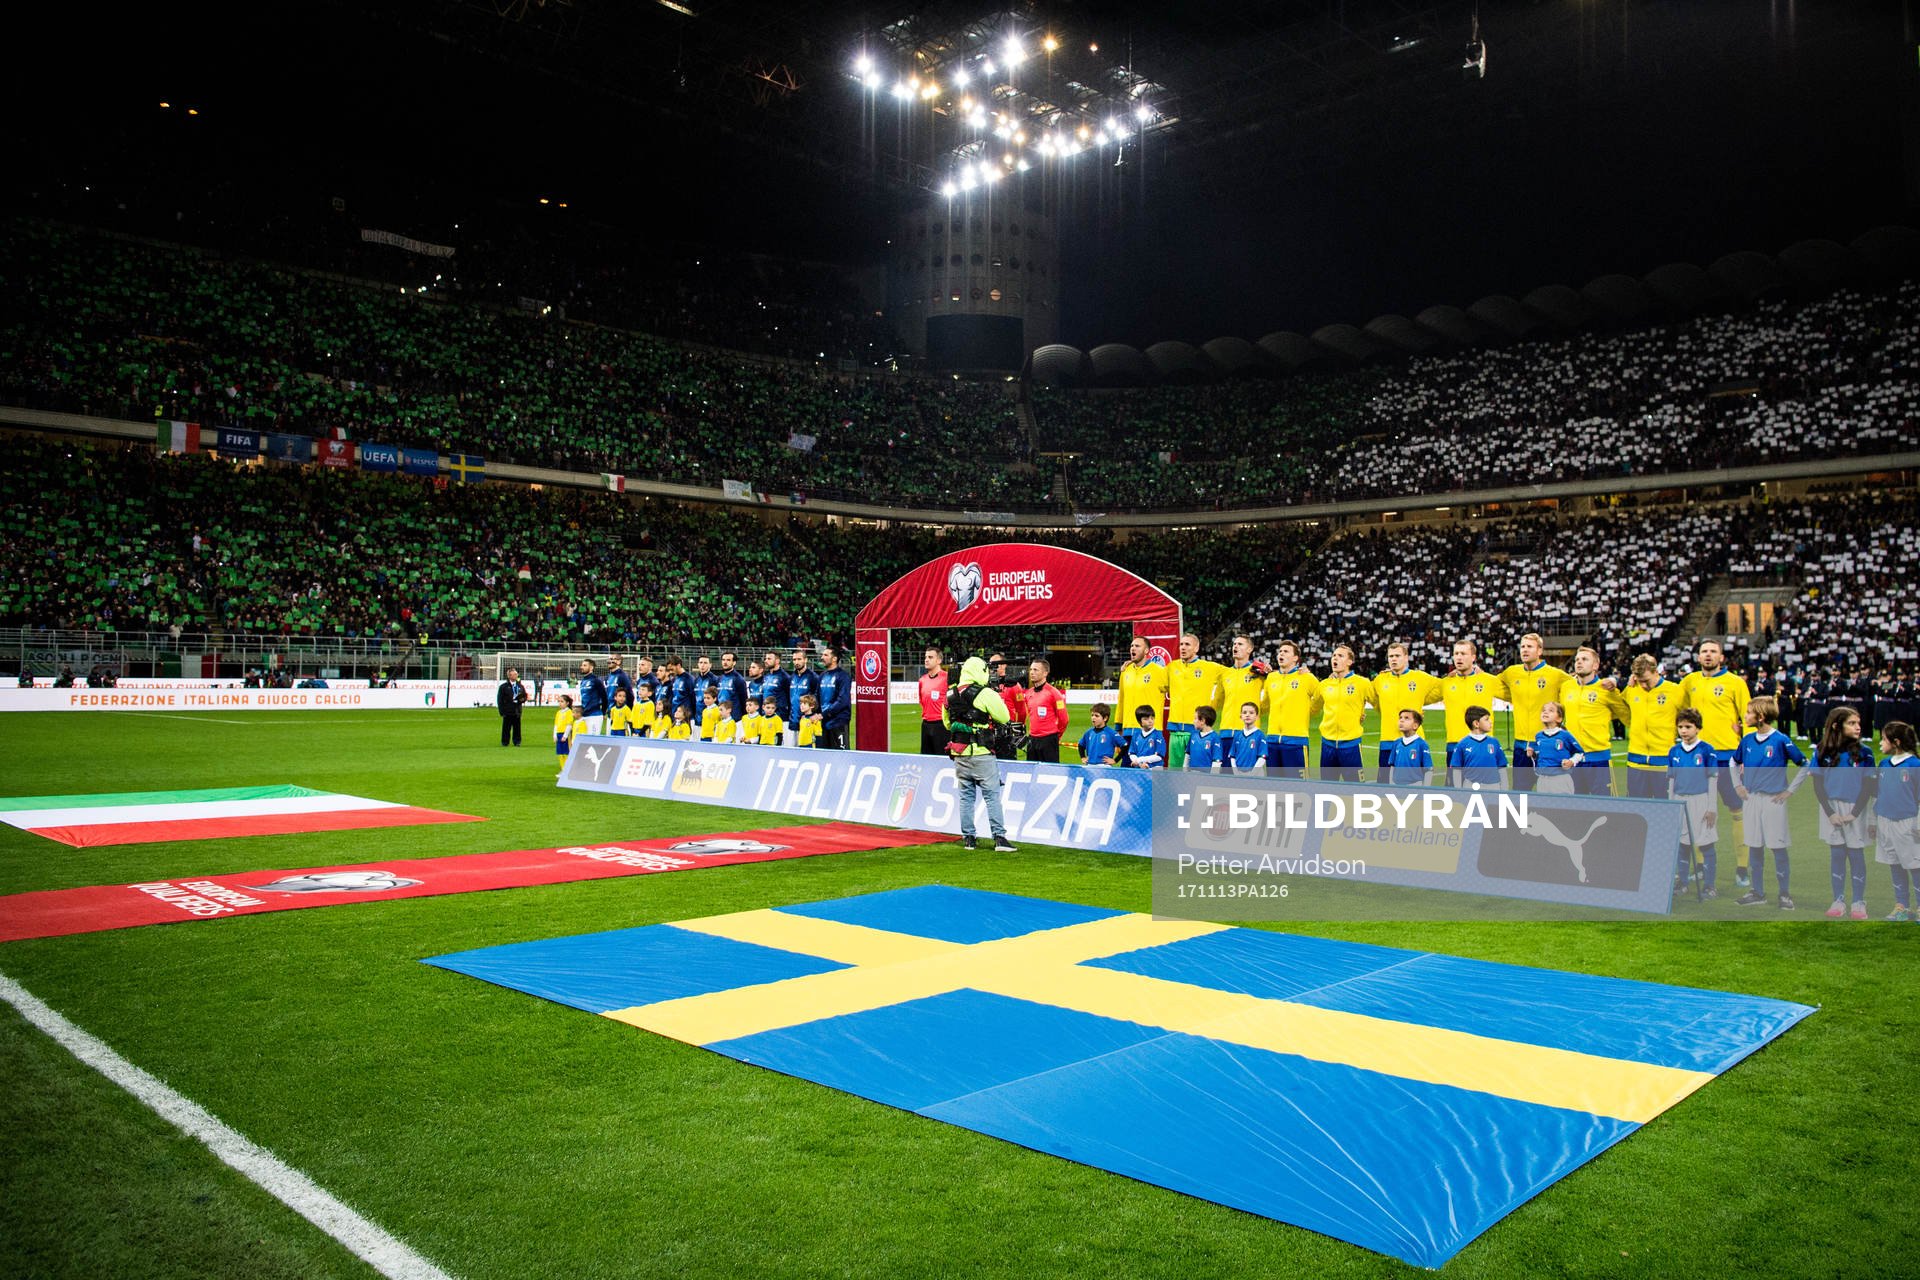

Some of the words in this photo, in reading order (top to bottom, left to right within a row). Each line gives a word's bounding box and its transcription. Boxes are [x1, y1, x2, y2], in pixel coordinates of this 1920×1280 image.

[226, 434, 252, 446] FIFA
[363, 451, 396, 464] UEFA
[989, 570, 1046, 585] EUROPEAN
[982, 584, 1053, 604] QUALIFIERS
[81, 652, 128, 664] PCENO
[1148, 649, 1166, 658] UEFA
[857, 685, 885, 696] RESPECT
[71, 695, 176, 706] FEDERAZIONE
[184, 695, 249, 705] ITALIANA
[258, 694, 308, 705] GIUOCO
[315, 694, 361, 705] CALCIO
[838, 734, 844, 745] 1
[642, 759, 666, 778] TIM
[705, 757, 731, 781] eni
[753, 758, 883, 823] ITALIA
[924, 768, 1122, 846] SEZIA
[1327, 822, 1460, 848] Posteitaliane
[127, 882, 235, 916] QUALIFIERS
[179, 880, 267, 907] EUROPEAN
